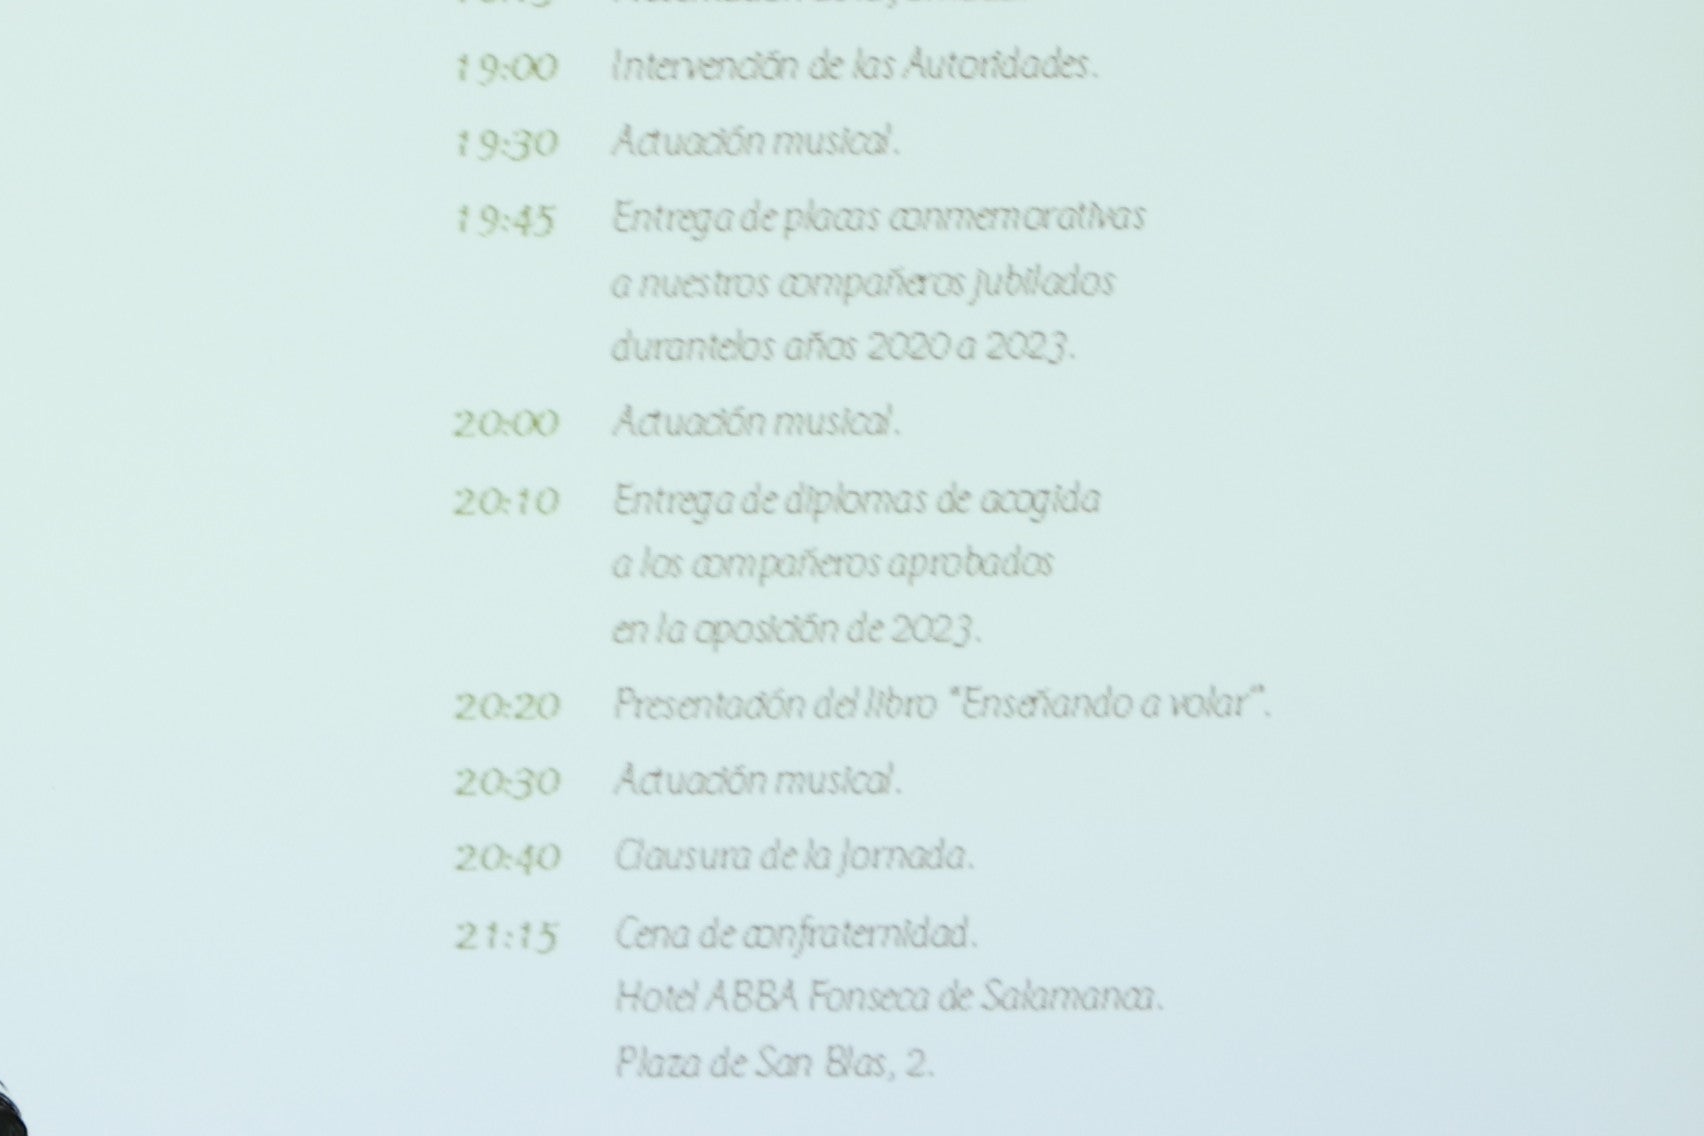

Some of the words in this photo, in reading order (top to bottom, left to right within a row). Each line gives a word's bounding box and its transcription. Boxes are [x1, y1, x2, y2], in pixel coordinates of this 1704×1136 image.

[458, 53, 559, 86] 19:00
[613, 49, 799, 82] Intervención
[808, 48, 845, 80] de
[852, 47, 896, 80] las
[902, 44, 1098, 79] Autoridades.
[458, 129, 559, 162] 19:30
[611, 123, 765, 157] Actuación
[773, 122, 899, 155] musical.
[459, 204, 556, 237] 19:45
[613, 199, 735, 242] Entrega
[740, 199, 778, 232] de
[783, 198, 881, 240] placas
[888, 201, 1147, 231] conmemorativas
[611, 274, 632, 298] a
[639, 270, 770, 298] nuestros
[779, 266, 967, 306] compañeros
[972, 264, 1116, 306] jubilados
[784, 331, 858, 362] años
[867, 330, 952, 361] 2020
[956, 336, 977, 360] a
[986, 330, 1075, 365] 2023.
[453, 409, 560, 438] 20:00
[612, 404, 766, 437] Actuación
[774, 403, 900, 436] musical.
[453, 487, 560, 516] 20:10
[614, 482, 736, 525] Entrega
[740, 482, 779, 515] de
[784, 482, 928, 523] diplomas
[936, 481, 972, 514] de
[980, 480, 1101, 524] acogida
[612, 554, 633, 578] a
[640, 546, 683, 579] los
[692, 547, 882, 587] compañeros
[887, 544, 1054, 585] aprobados
[612, 620, 649, 644] en
[656, 612, 687, 644] la
[694, 613, 839, 652] oposición
[846, 611, 885, 643] de
[891, 613, 981, 648] 2023.
[454, 692, 561, 720] 20:20
[615, 686, 806, 720] Presentación
[813, 686, 860, 719] del
[864, 686, 938, 719] libro
[1140, 694, 1161, 718] a
[454, 767, 561, 801] 20:30
[613, 762, 767, 796] Actuación
[775, 761, 901, 795] musical.
[455, 843, 561, 876] 20:40
[615, 838, 752, 871] Clausura
[760, 838, 798, 870] de
[803, 838, 831, 870] la
[455, 921, 559, 955] 21:15
[616, 915, 690, 949] Cena
[698, 917, 737, 949] de
[742, 914, 977, 958] confraternidad.
[616, 980, 699, 1012] Hotel
[704, 978, 798, 1012] ABBA
[809, 979, 930, 1012] Fonseca
[938, 979, 974, 1011] de
[616, 1045, 702, 1078] Plaza
[709, 1046, 748, 1078] de
[754, 1045, 813, 1078] San
[906, 1048, 934, 1078] 2.
